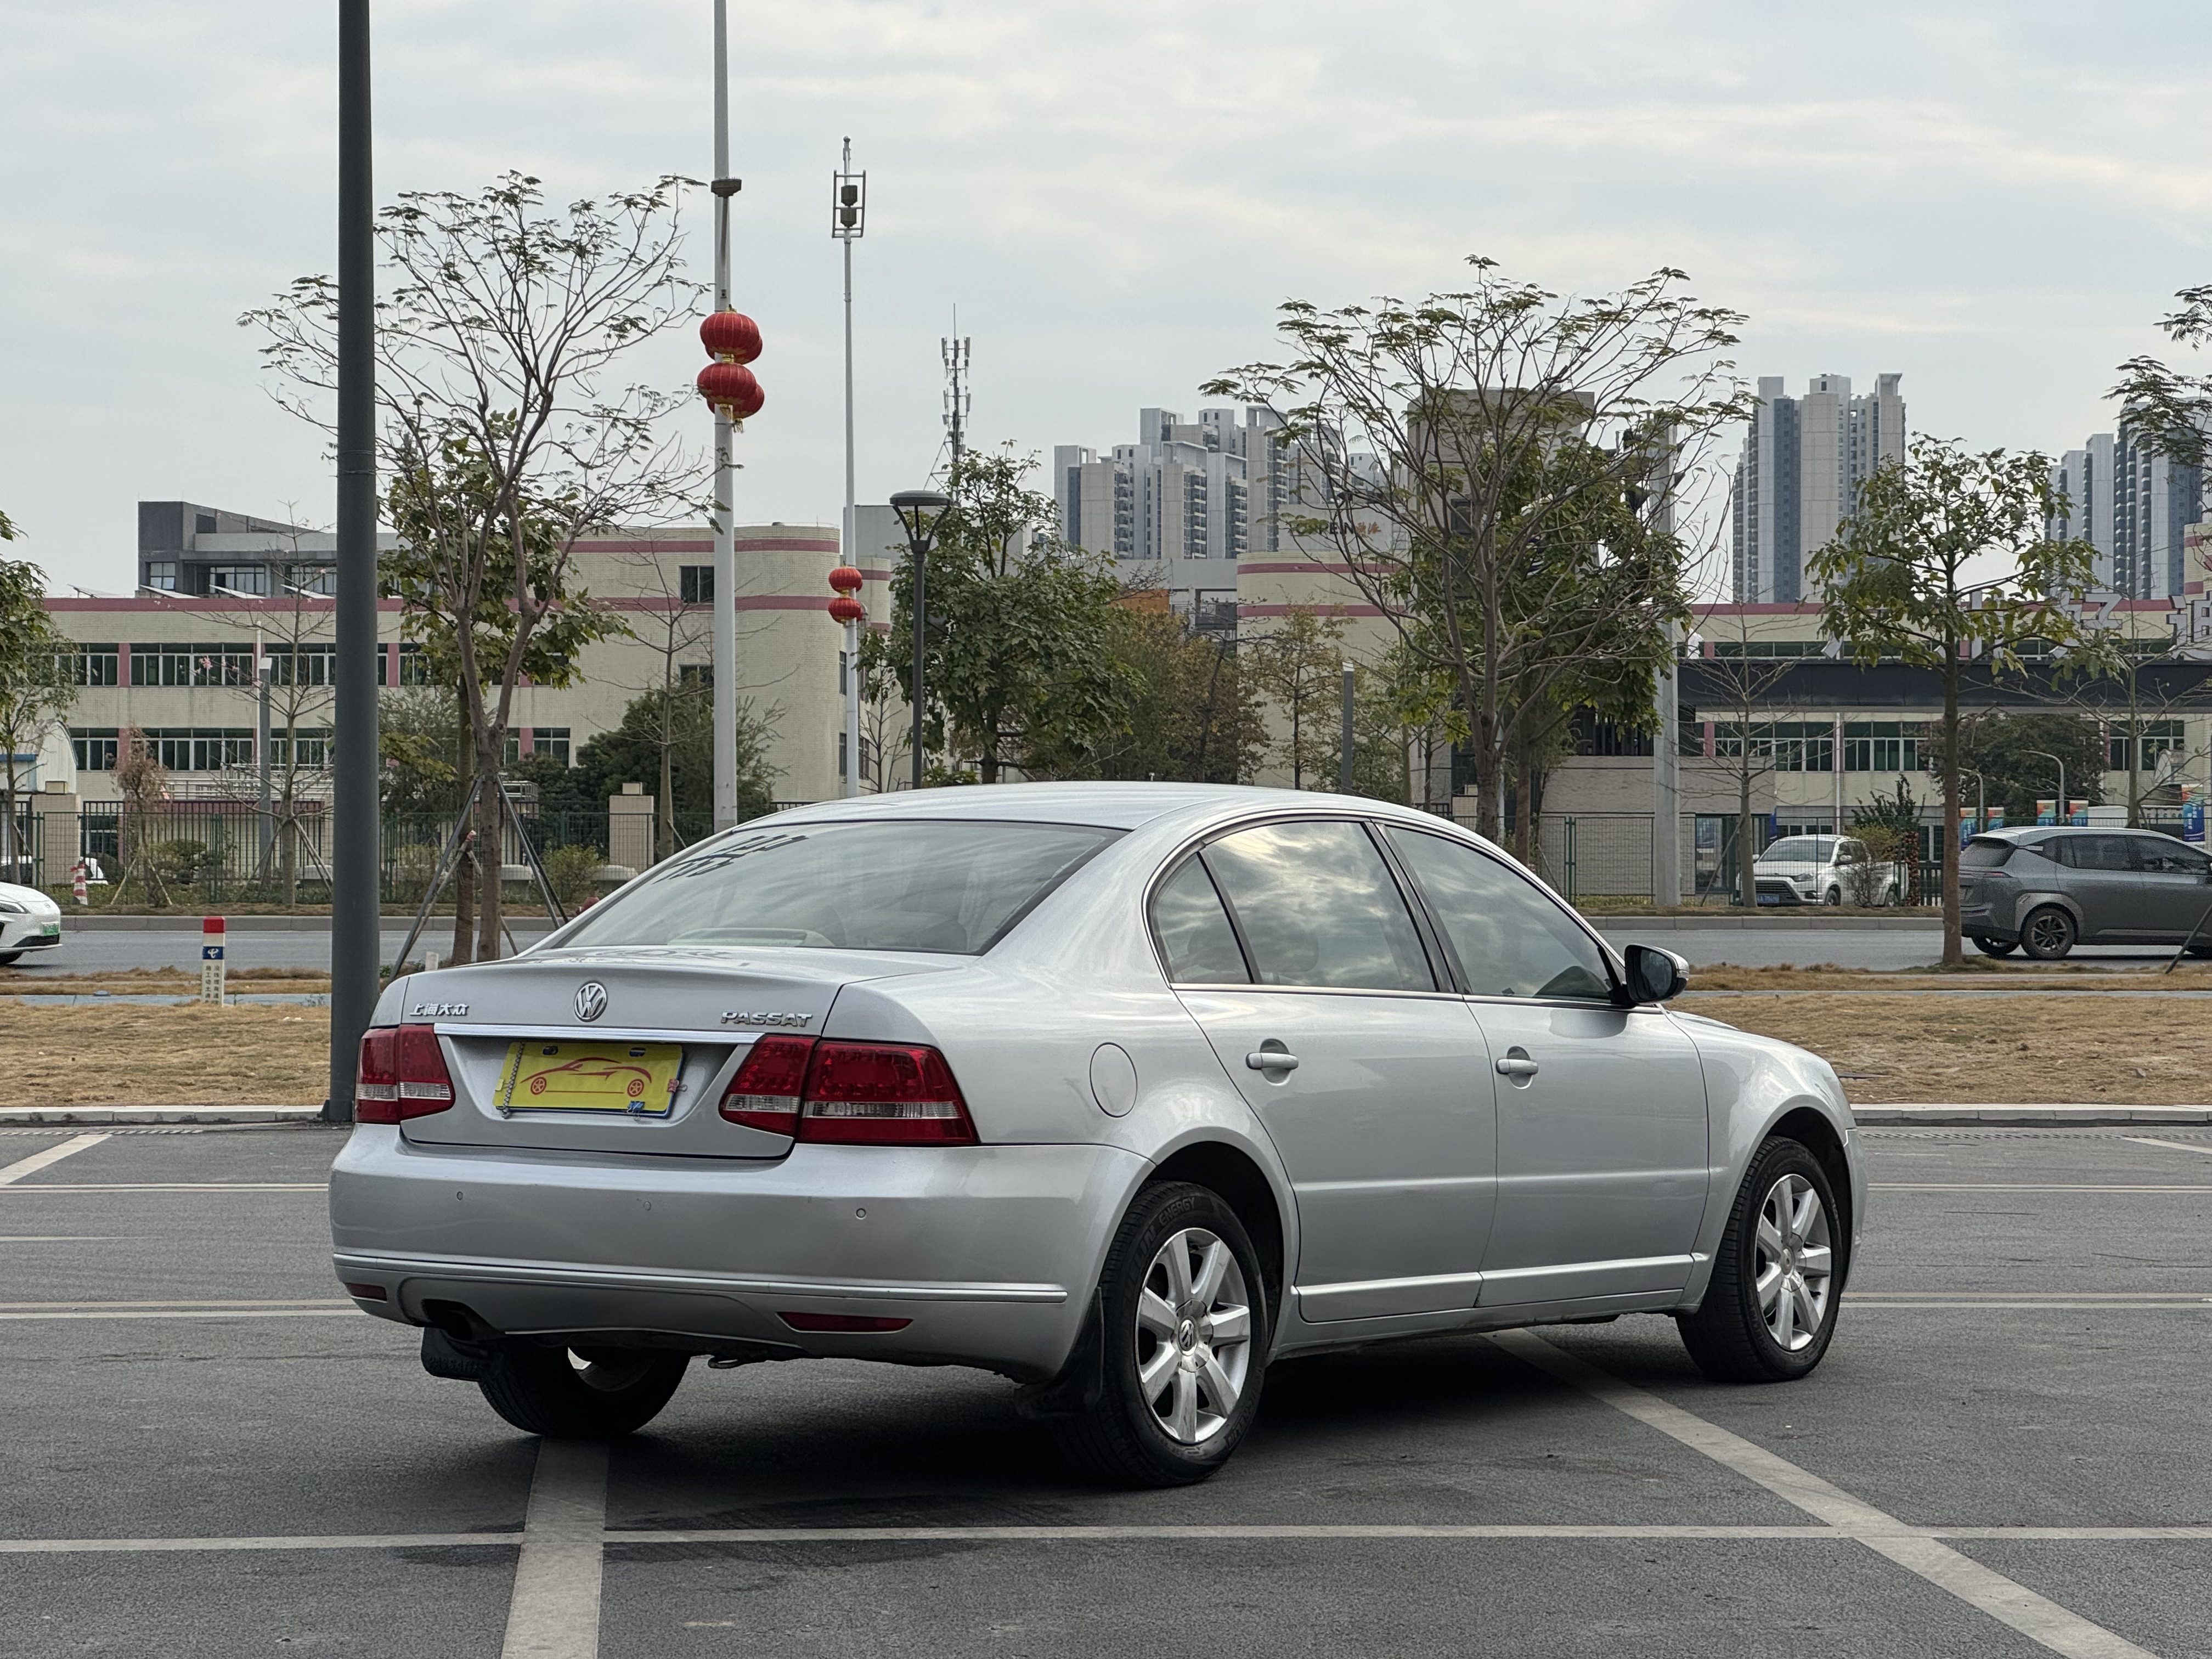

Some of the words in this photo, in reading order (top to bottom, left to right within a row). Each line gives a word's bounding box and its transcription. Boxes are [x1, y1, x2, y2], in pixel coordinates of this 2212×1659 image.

[409, 1002, 469, 1016] 上海大众
[574, 982, 607, 1020] VW
[721, 1009, 813, 1027] PASSAT
[1158, 1197, 1195, 1226] ENERGY
